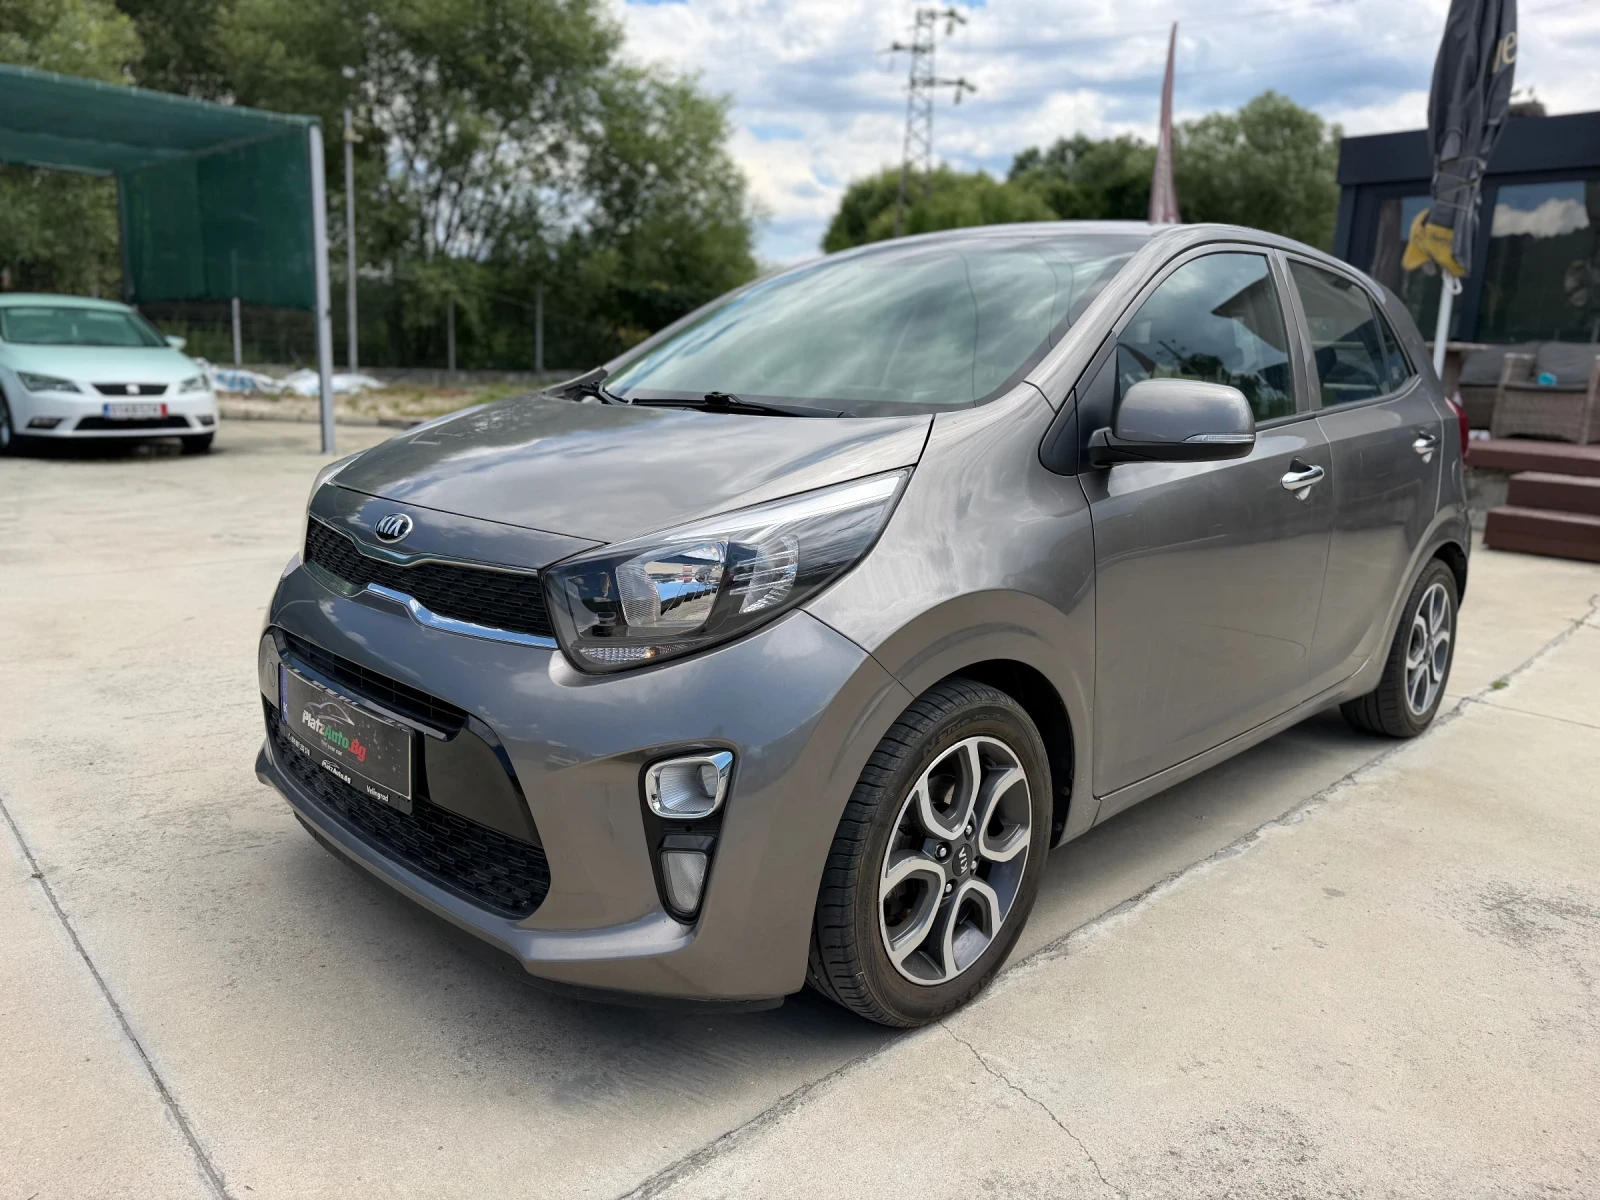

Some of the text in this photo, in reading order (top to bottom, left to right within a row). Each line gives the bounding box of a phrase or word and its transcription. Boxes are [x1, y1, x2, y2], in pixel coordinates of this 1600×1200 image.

[376, 515, 404, 537] KIA
[366, 785, 389, 802] Velingrad
[958, 846, 968, 875] KIA
